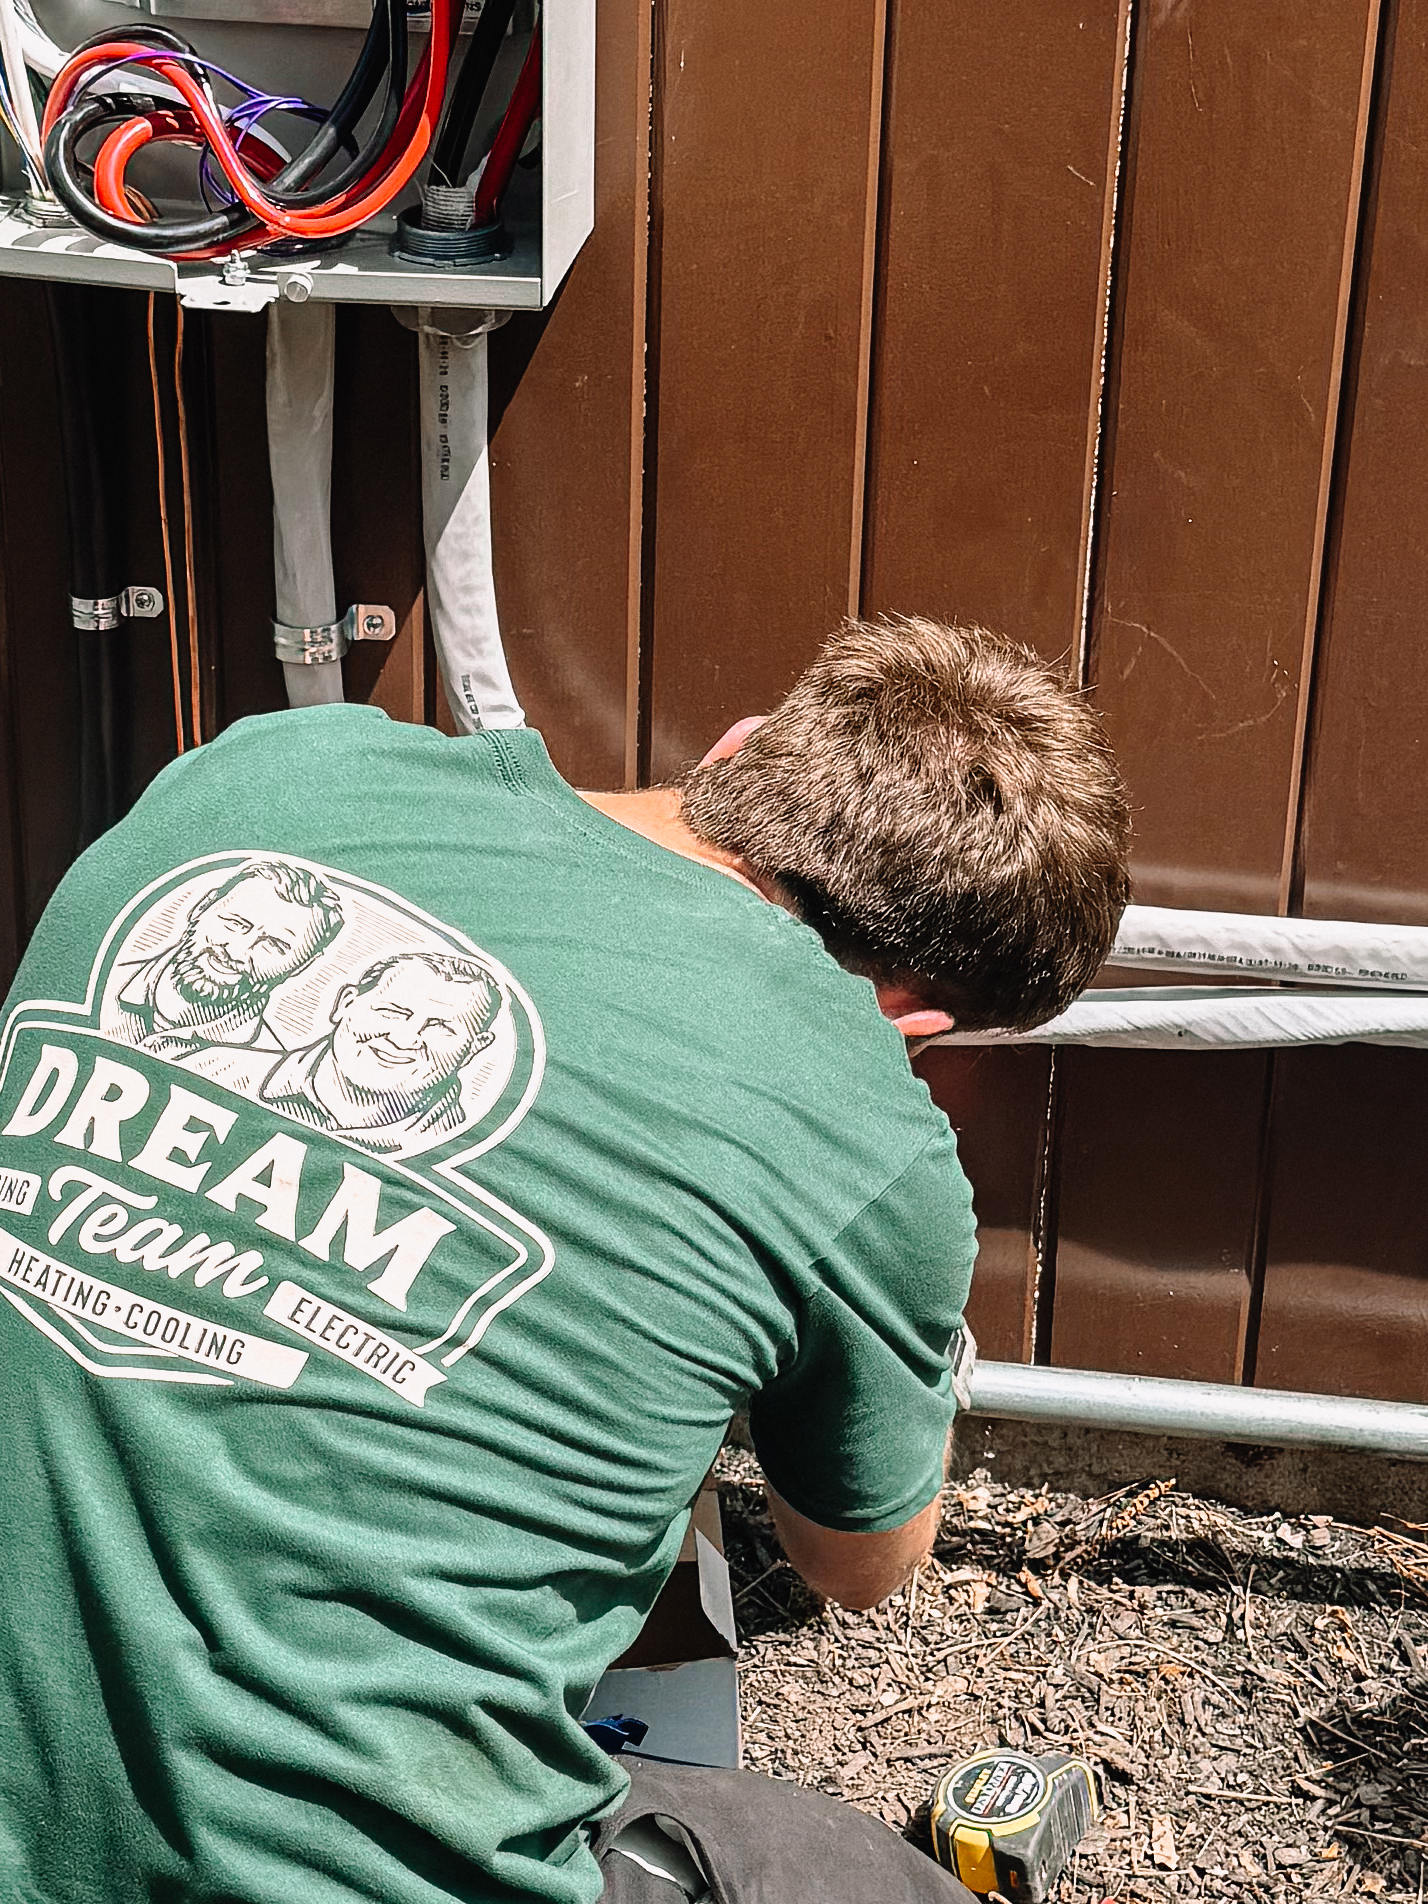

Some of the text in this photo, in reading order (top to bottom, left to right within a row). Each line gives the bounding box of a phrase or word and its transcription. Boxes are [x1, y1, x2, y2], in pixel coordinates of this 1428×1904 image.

[1, 1043, 458, 1313] DREAM
[48, 1165, 270, 1298] Team
[288, 1296, 417, 1386] ELECTRIC
